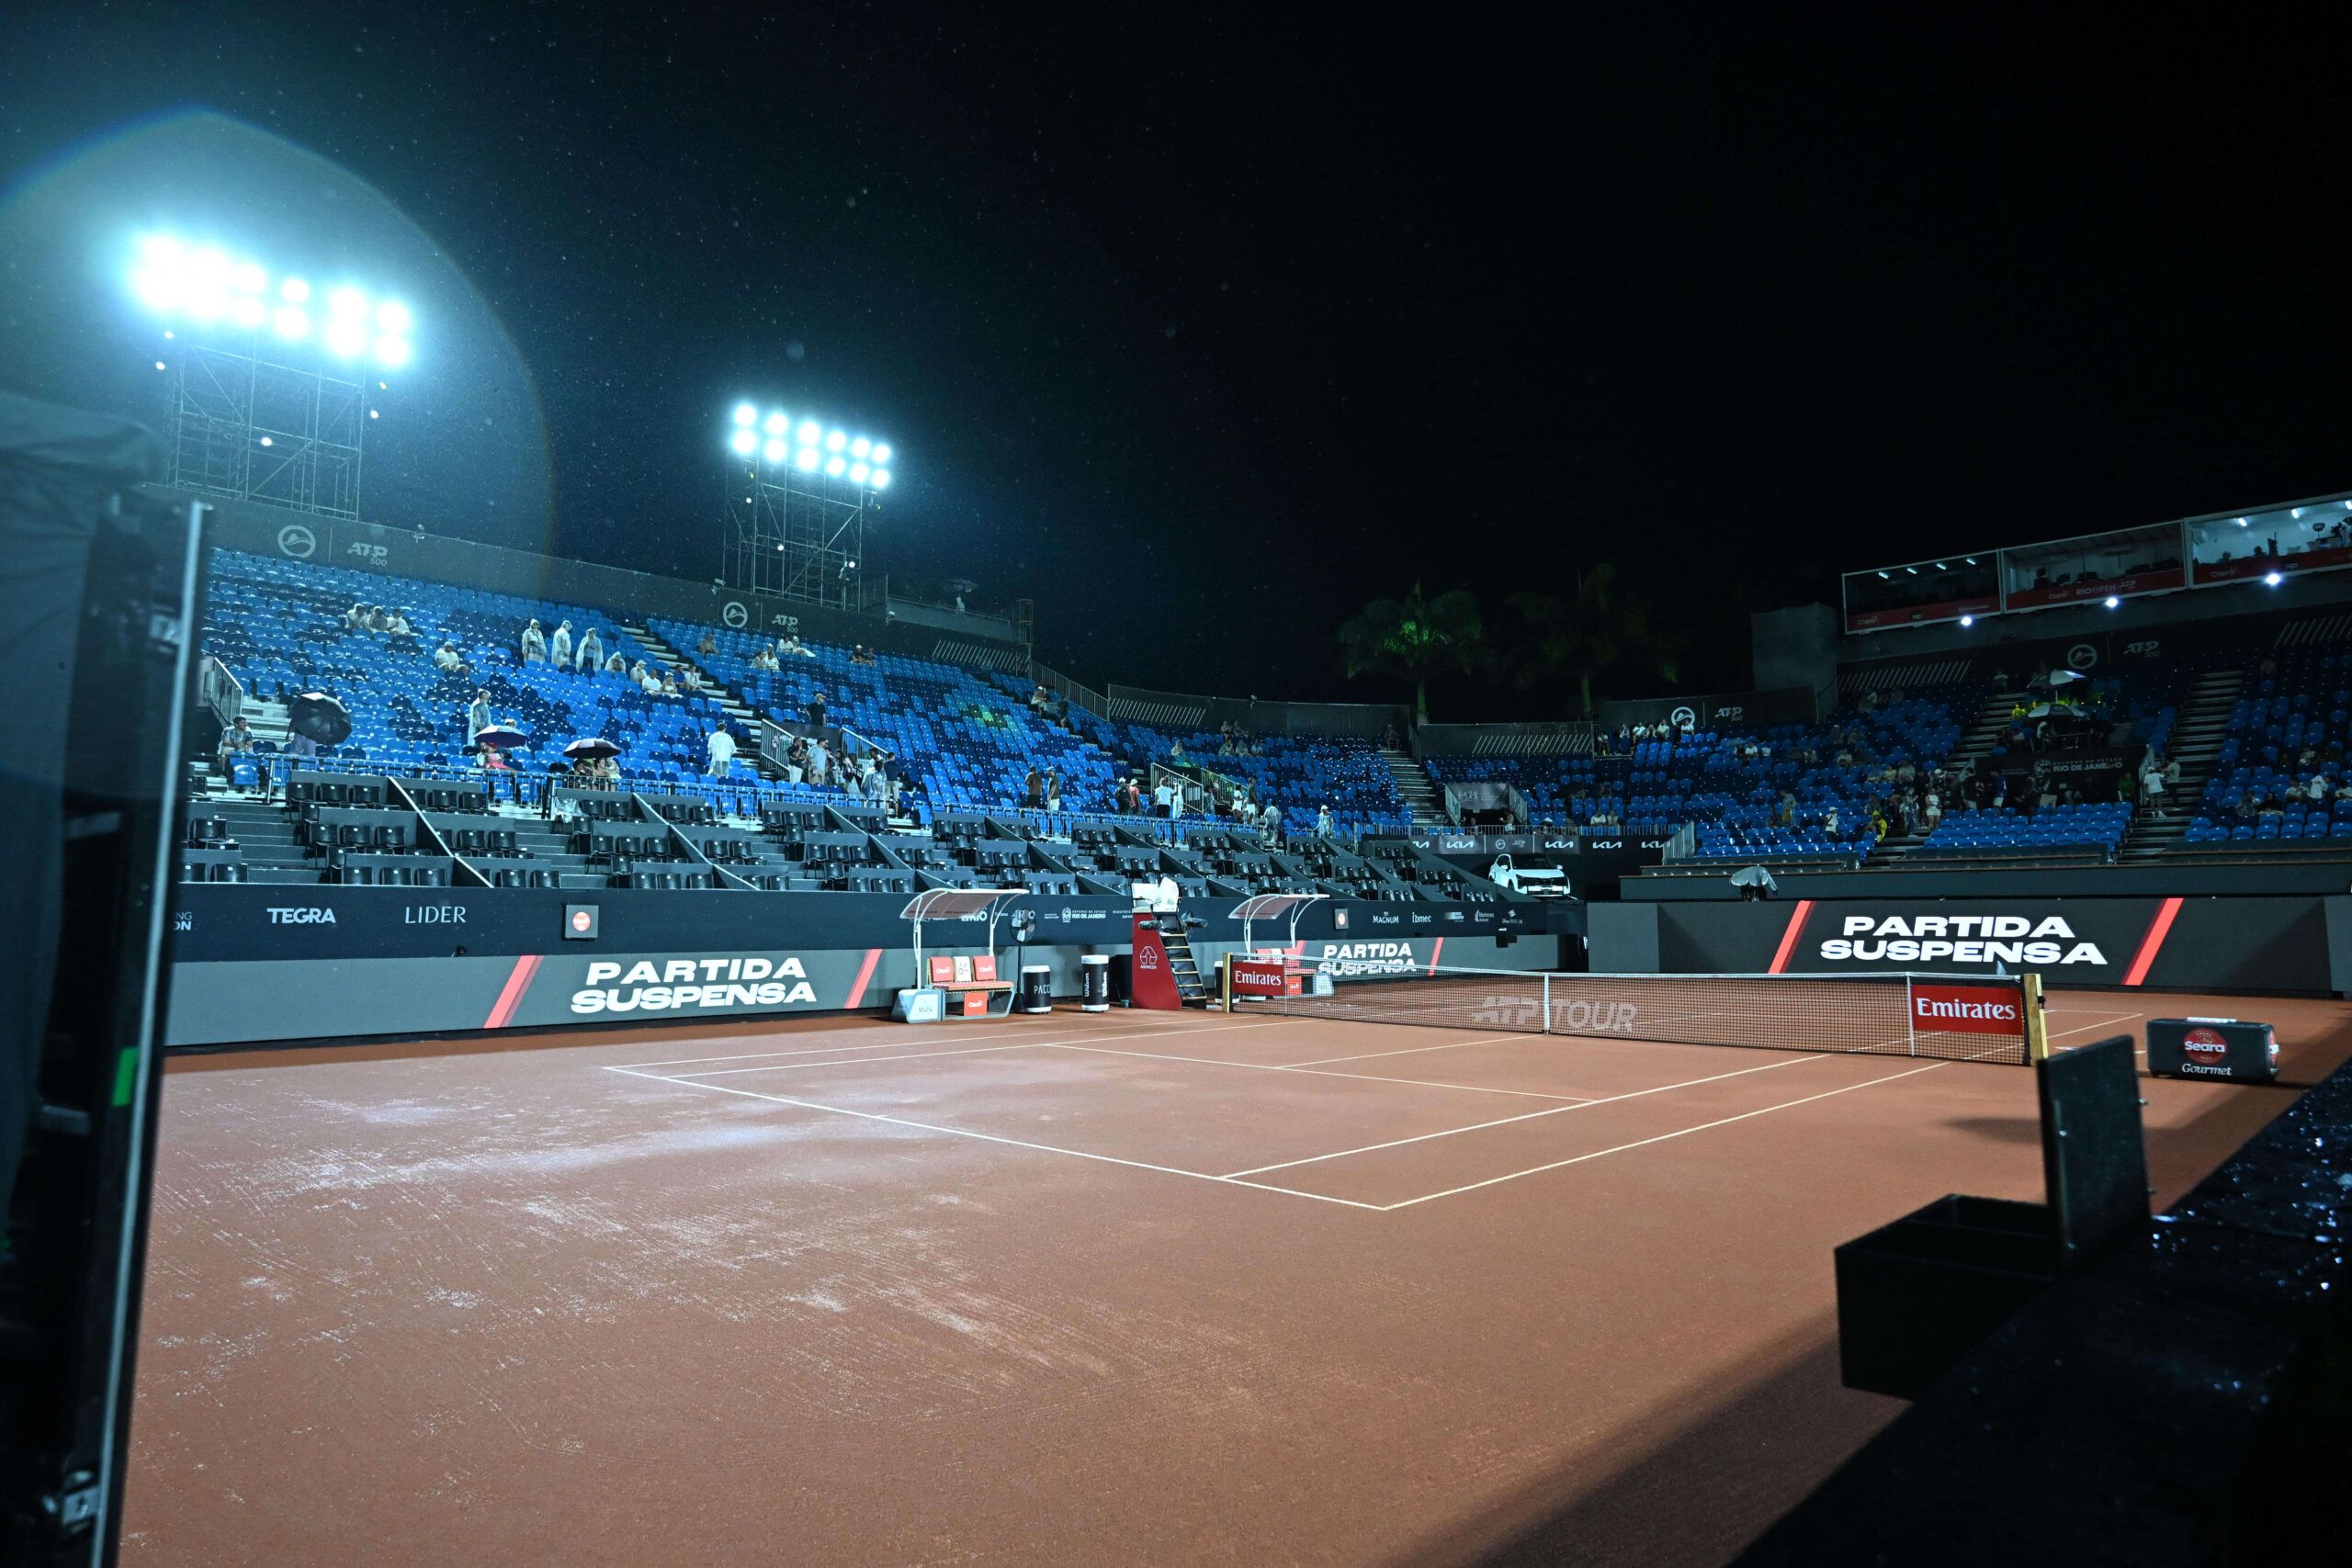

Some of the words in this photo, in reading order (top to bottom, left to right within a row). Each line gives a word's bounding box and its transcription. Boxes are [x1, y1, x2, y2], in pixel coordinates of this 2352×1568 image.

[346, 542, 388, 558] ATP
[368, 558, 388, 567] 500
[772, 614, 799, 626] ATP
[2122, 640, 2160, 657] ATP
[1714, 706, 1743, 718] ATP
[2084, 761, 2123, 772] JANEO
[1446, 840, 1475, 849] KIA
[1544, 840, 1574, 849] KIA
[1592, 840, 1622, 849] KIA
[266, 908, 336, 924] TEGRA
[404, 906, 467, 924] LIDER
[1373, 915, 1399, 924] MAGNUM
[1842, 916, 2075, 938] PARTIDA
[1323, 942, 1413, 959] PARTIDA
[1820, 940, 2109, 964] SUSPENSA
[585, 957, 808, 986] PARTIDA
[1317, 958, 1418, 976] SUSPENSA
[1235, 970, 1282, 987] Emirates
[571, 981, 817, 1014] SUSPENSA
[1471, 997, 1540, 1025] ATP
[1552, 998, 1638, 1032] TOUR
[1916, 998, 2017, 1021] Emirates
[2184, 1040, 2226, 1053] Seara
[2181, 1063, 2233, 1076] Gourmet
